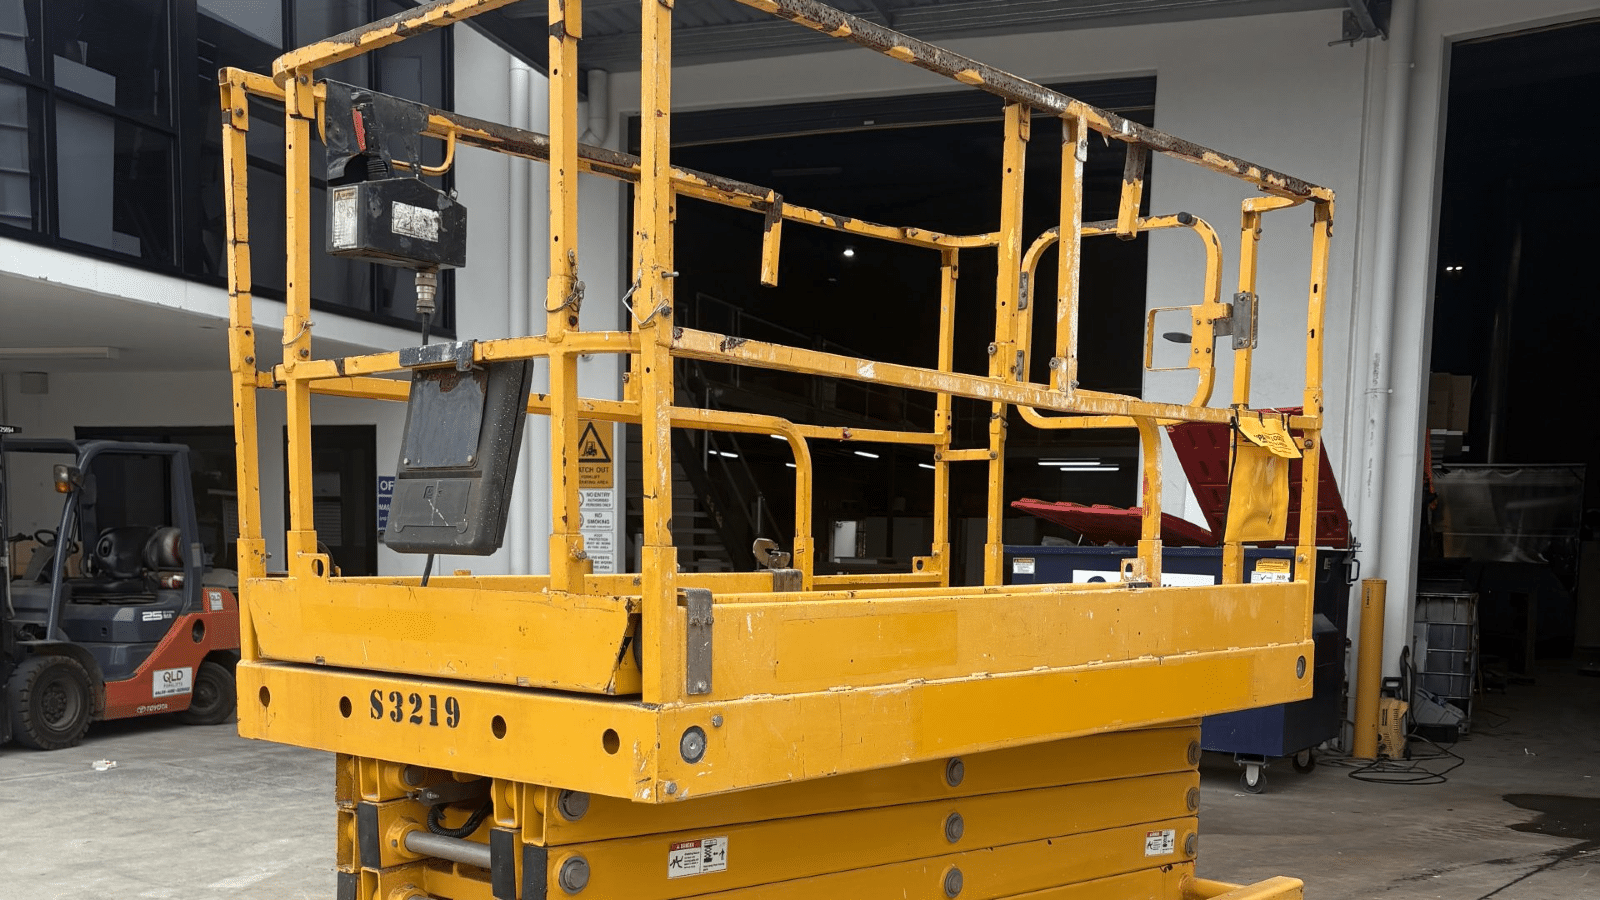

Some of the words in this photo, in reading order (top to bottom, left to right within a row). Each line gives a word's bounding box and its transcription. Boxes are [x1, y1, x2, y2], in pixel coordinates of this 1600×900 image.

[579, 466, 594, 474] ATCH
[595, 466, 610, 474] OUT
[142, 611, 163, 621] 25
[163, 670, 184, 684] QLD
[146, 703, 168, 711] TOYOTA
[369, 688, 461, 729] S3219
